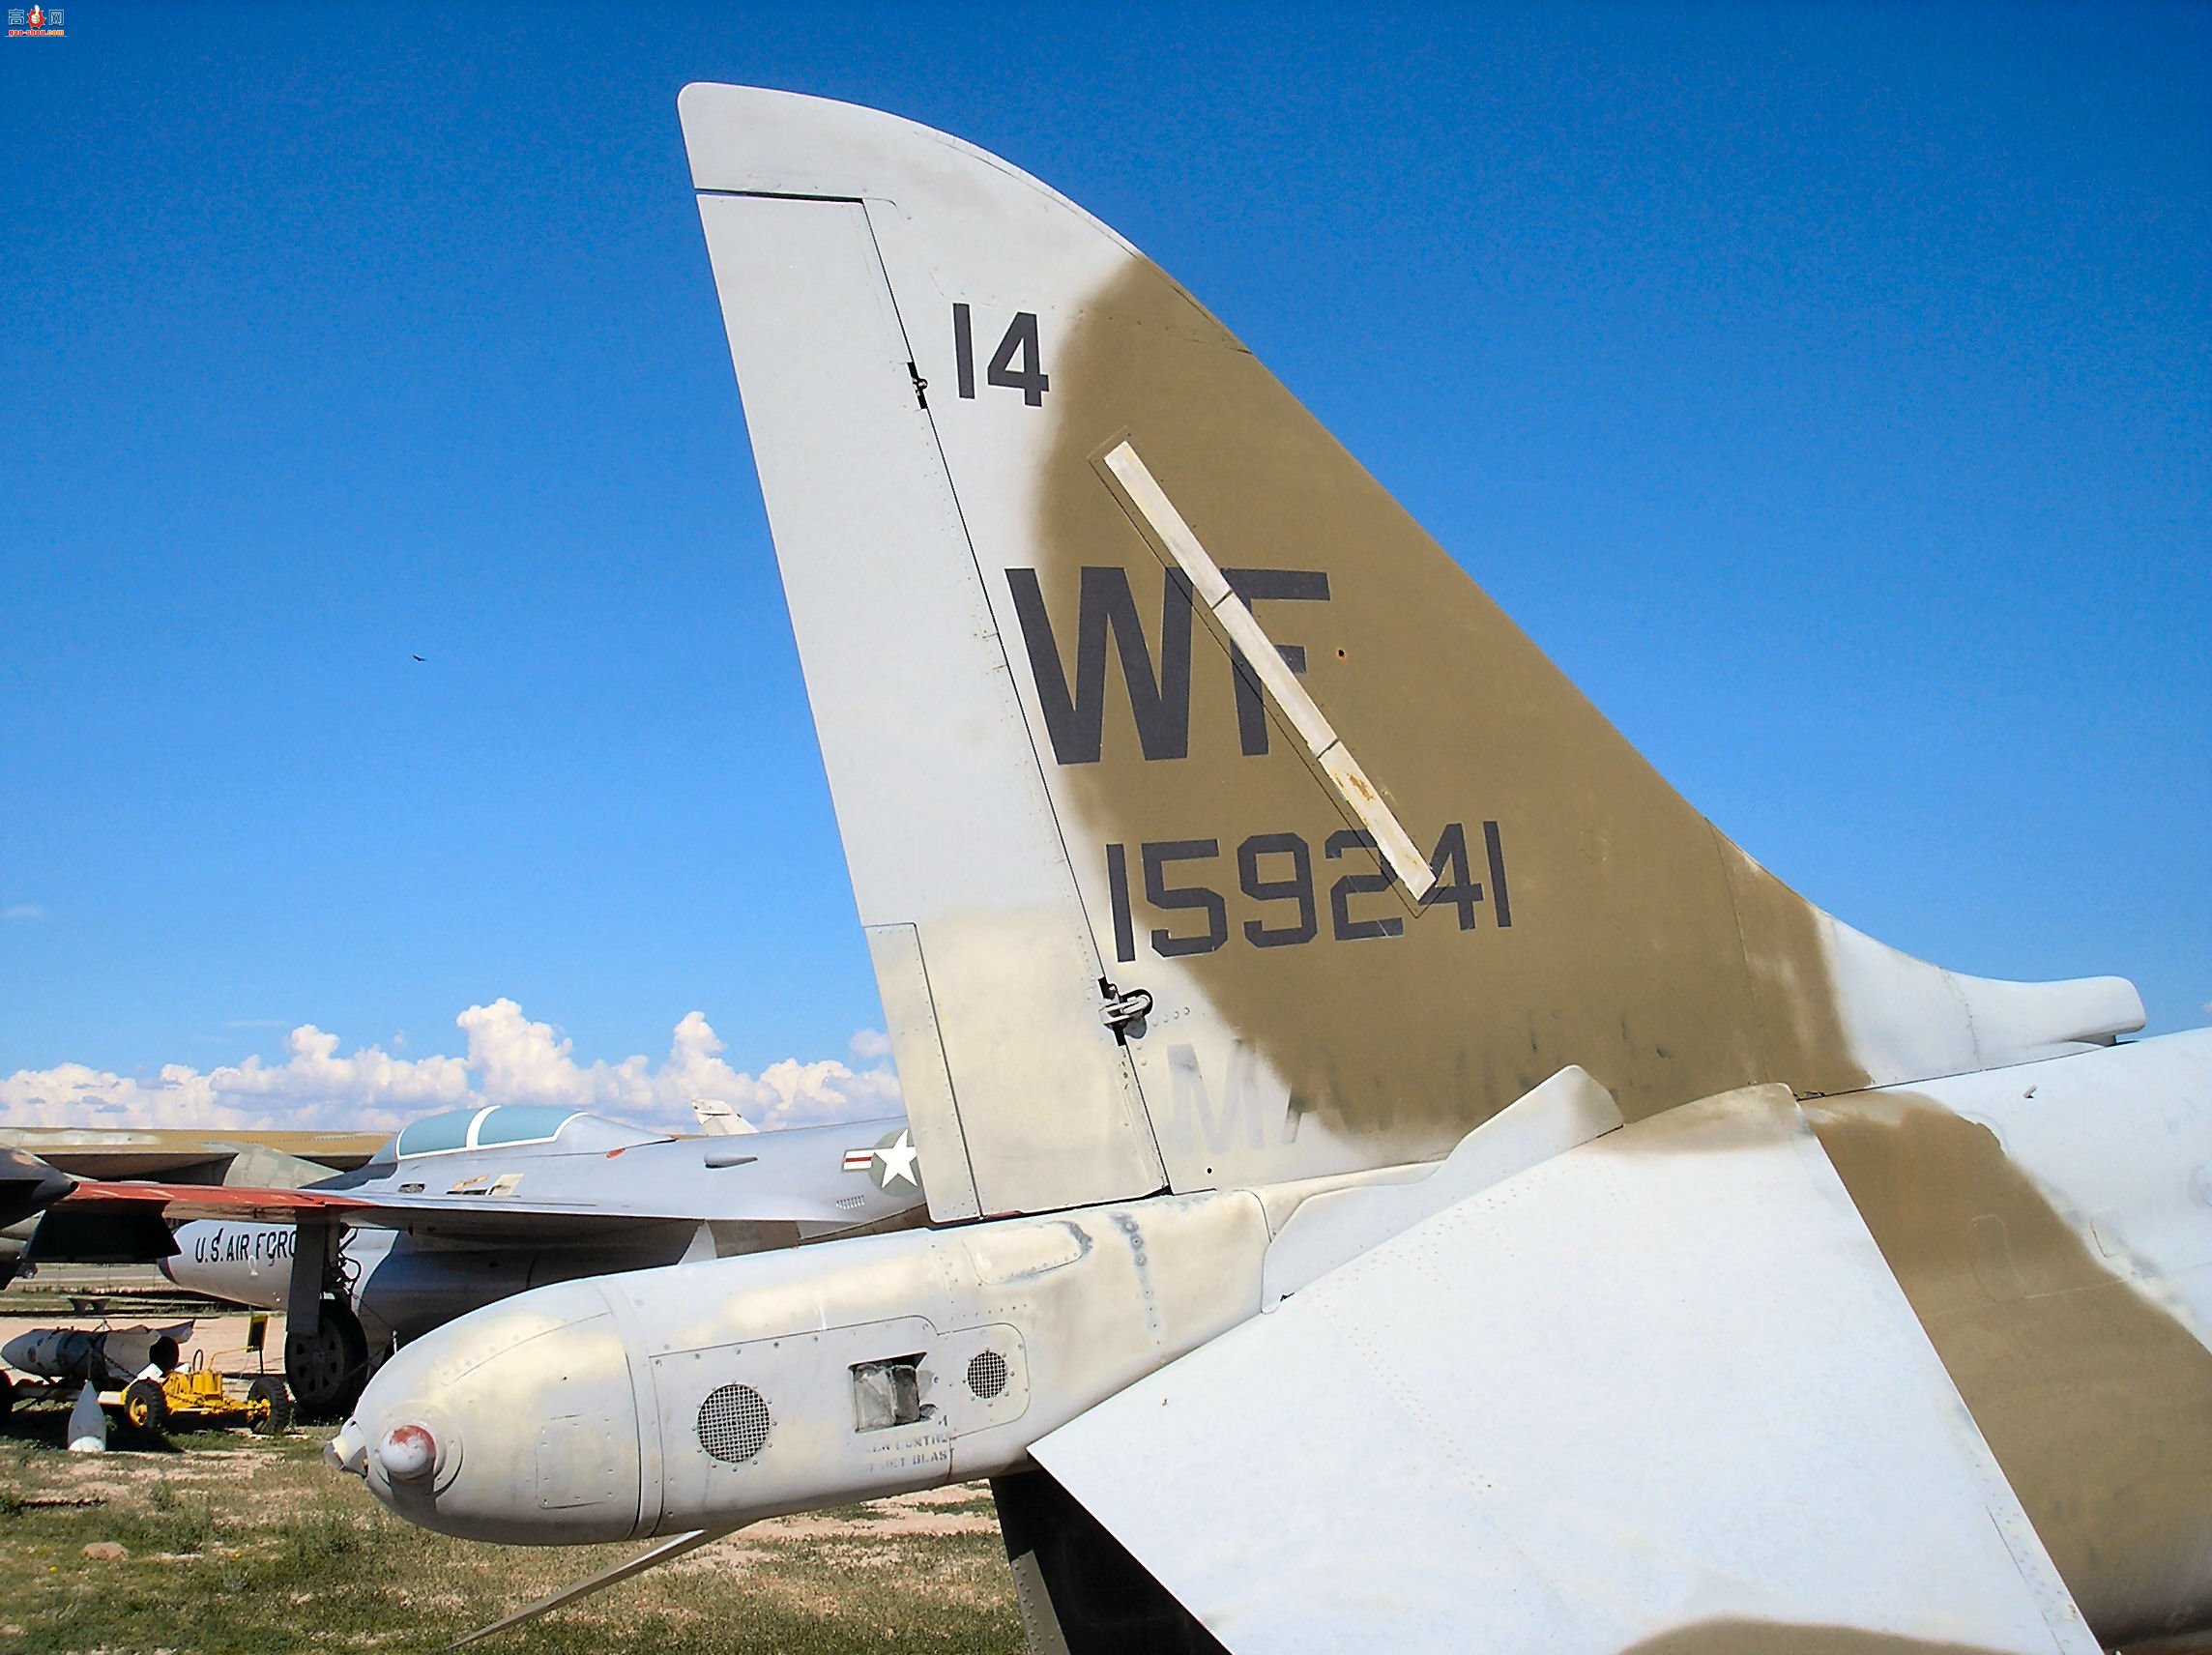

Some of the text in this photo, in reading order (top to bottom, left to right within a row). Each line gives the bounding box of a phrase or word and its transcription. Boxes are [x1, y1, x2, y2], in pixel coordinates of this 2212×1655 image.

[952, 303, 1050, 407] 14
[1004, 566, 1331, 766] WF
[1105, 820, 1512, 963] 159241
[195, 1230, 297, 1263] U.S. AIR FORC
